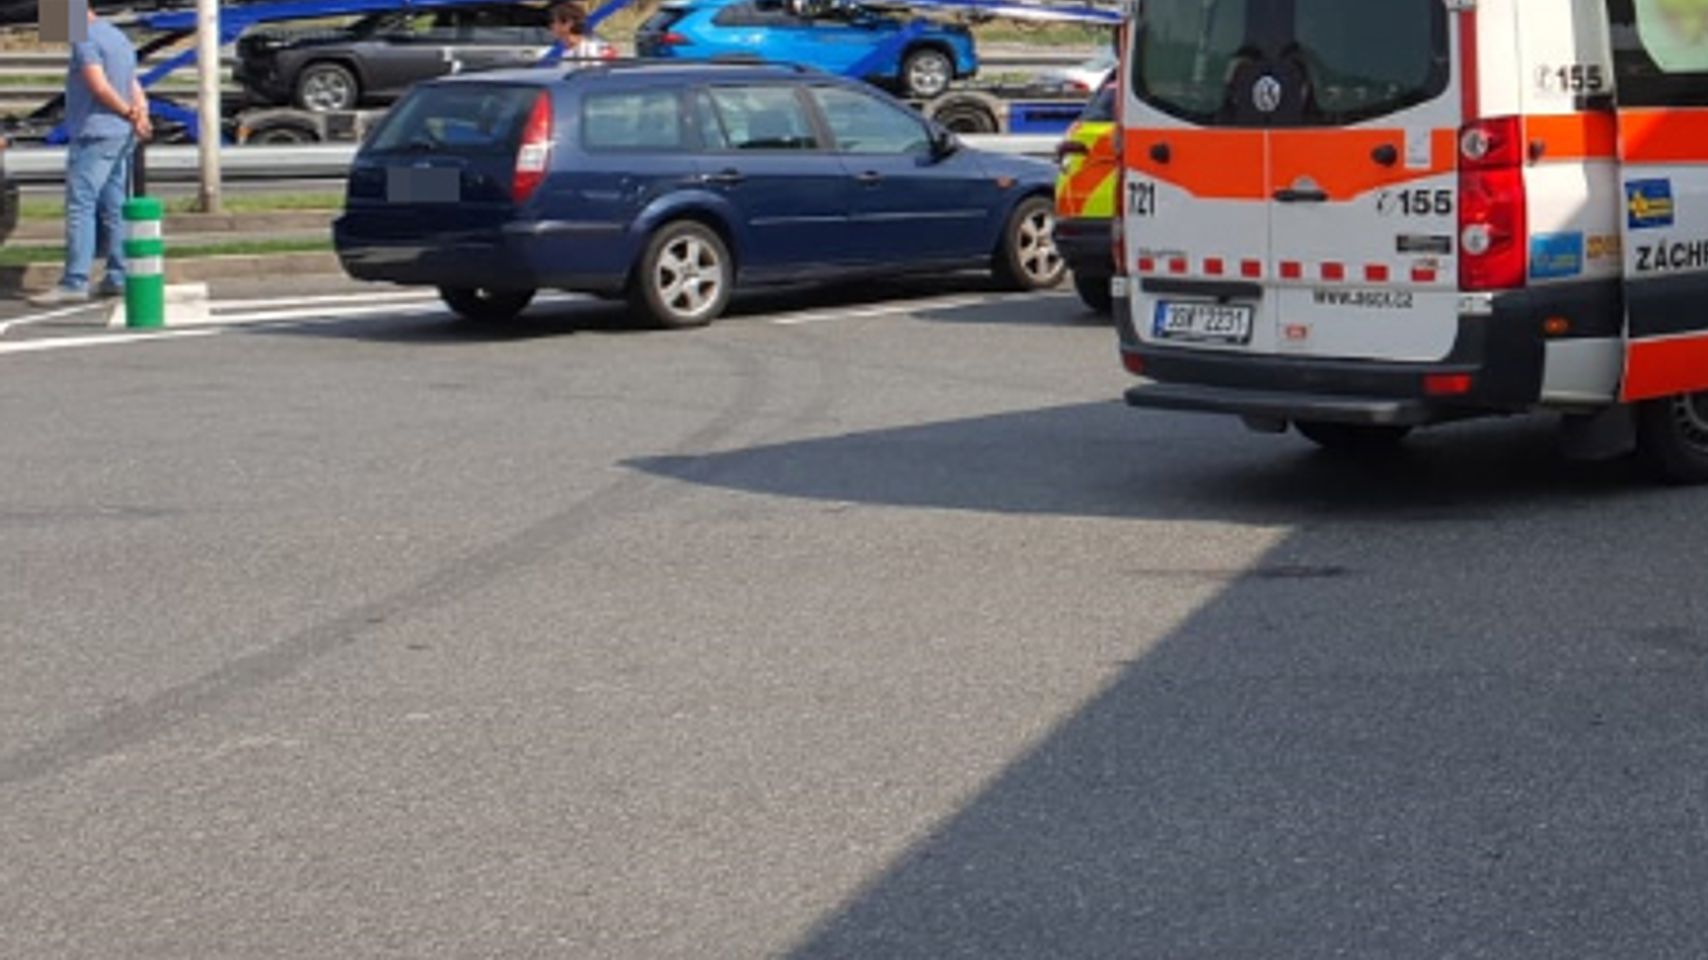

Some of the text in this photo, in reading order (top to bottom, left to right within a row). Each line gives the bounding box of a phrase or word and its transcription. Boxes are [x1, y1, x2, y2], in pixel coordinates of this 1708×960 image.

[1558, 65, 1603, 90] 155
[1128, 182, 1155, 215] 721
[1399, 190, 1452, 215] 155
